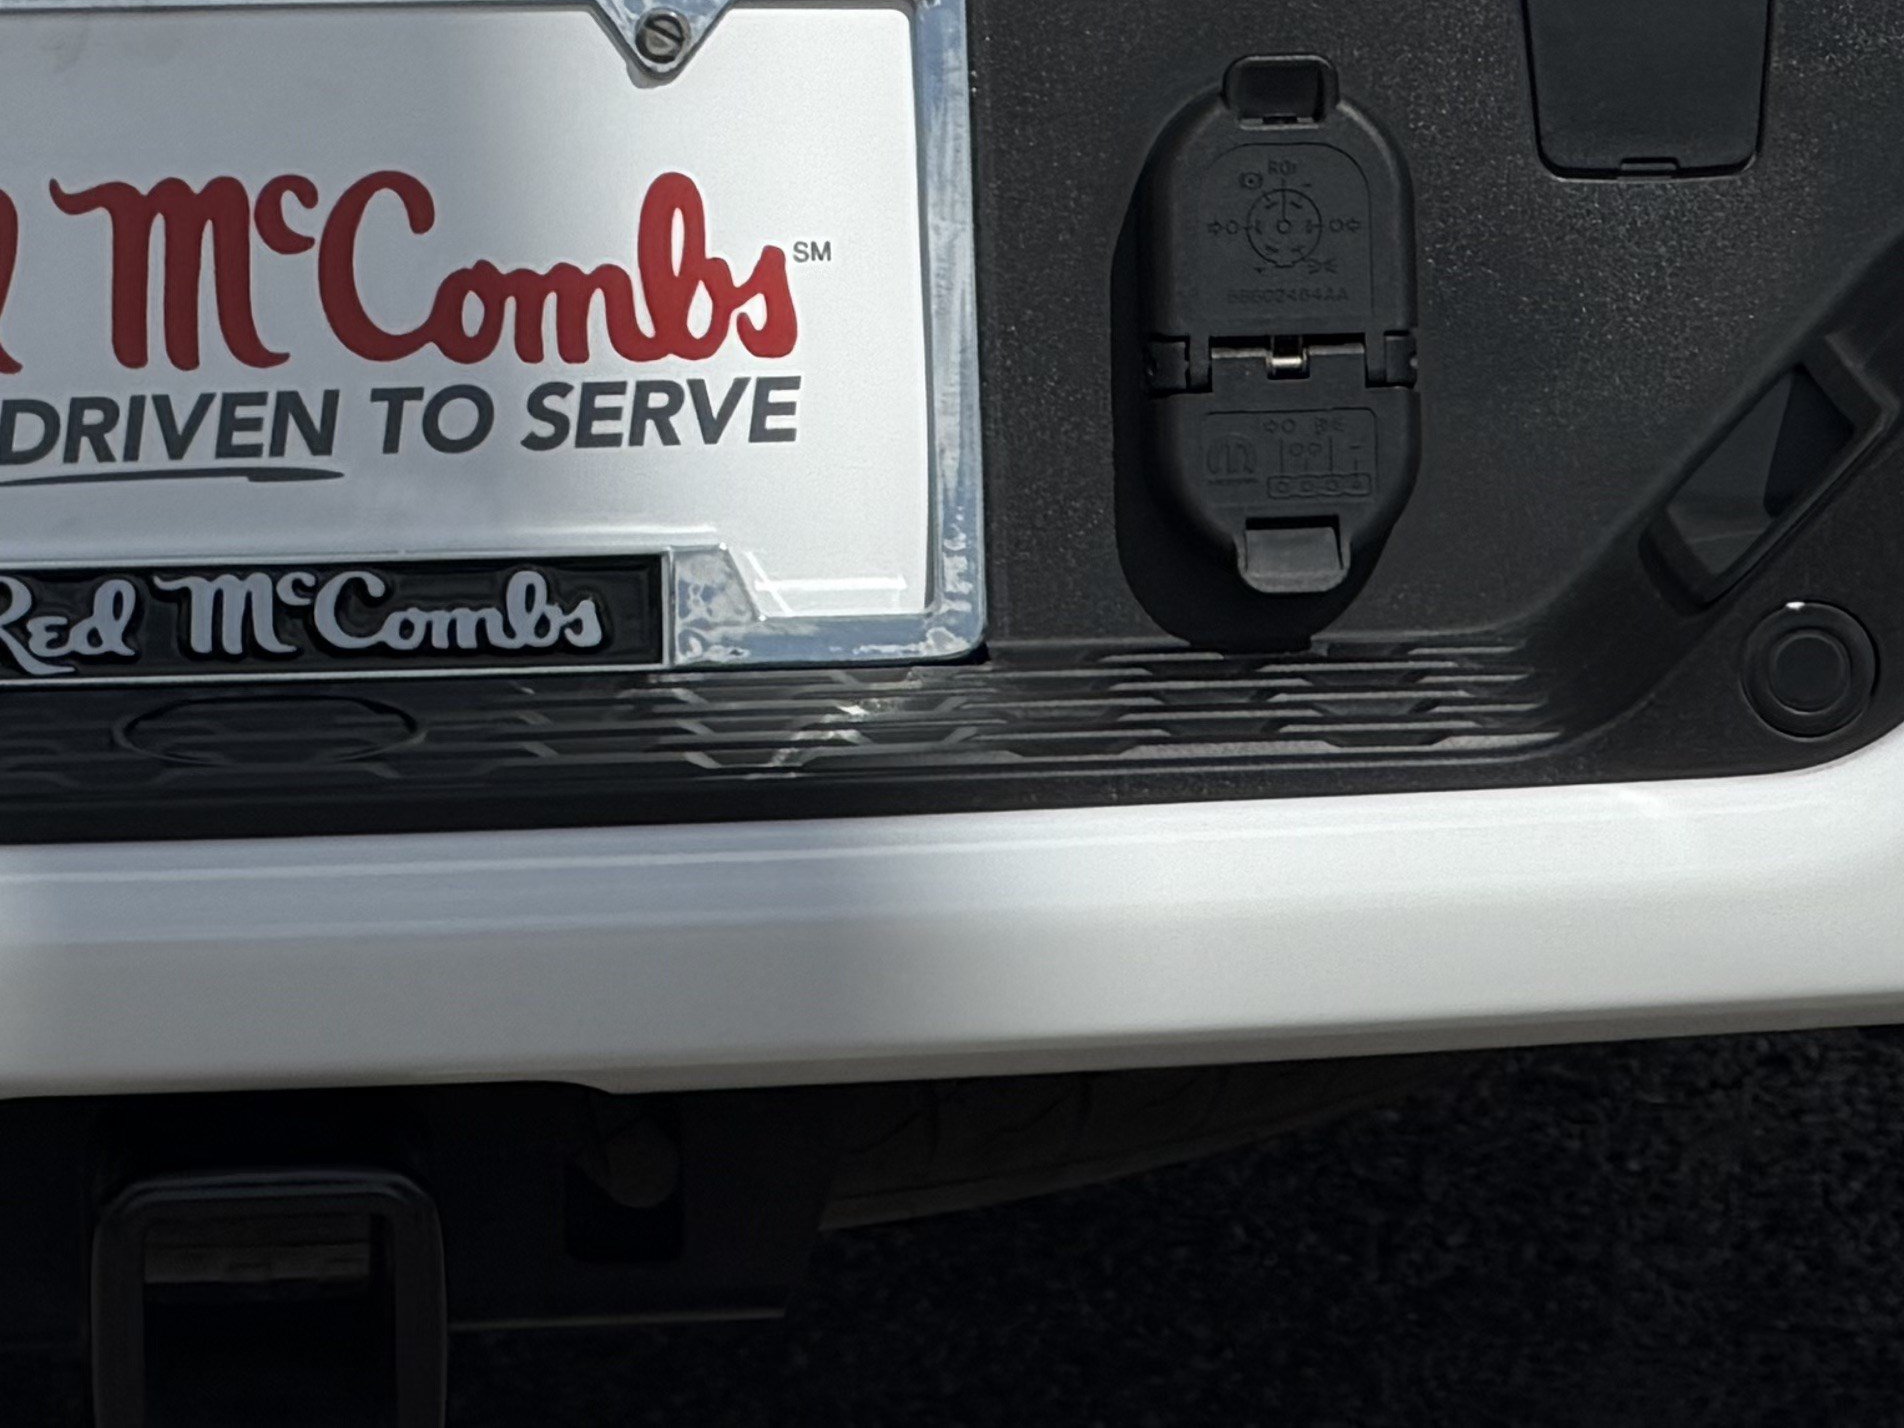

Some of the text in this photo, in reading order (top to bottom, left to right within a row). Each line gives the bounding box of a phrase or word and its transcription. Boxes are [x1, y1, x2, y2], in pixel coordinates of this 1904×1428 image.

[49, 170, 798, 371] McCombs
[793, 241, 831, 263] SM
[0, 376, 802, 465] DRIVEN TO SERVE
[152, 570, 602, 655] McCombs
